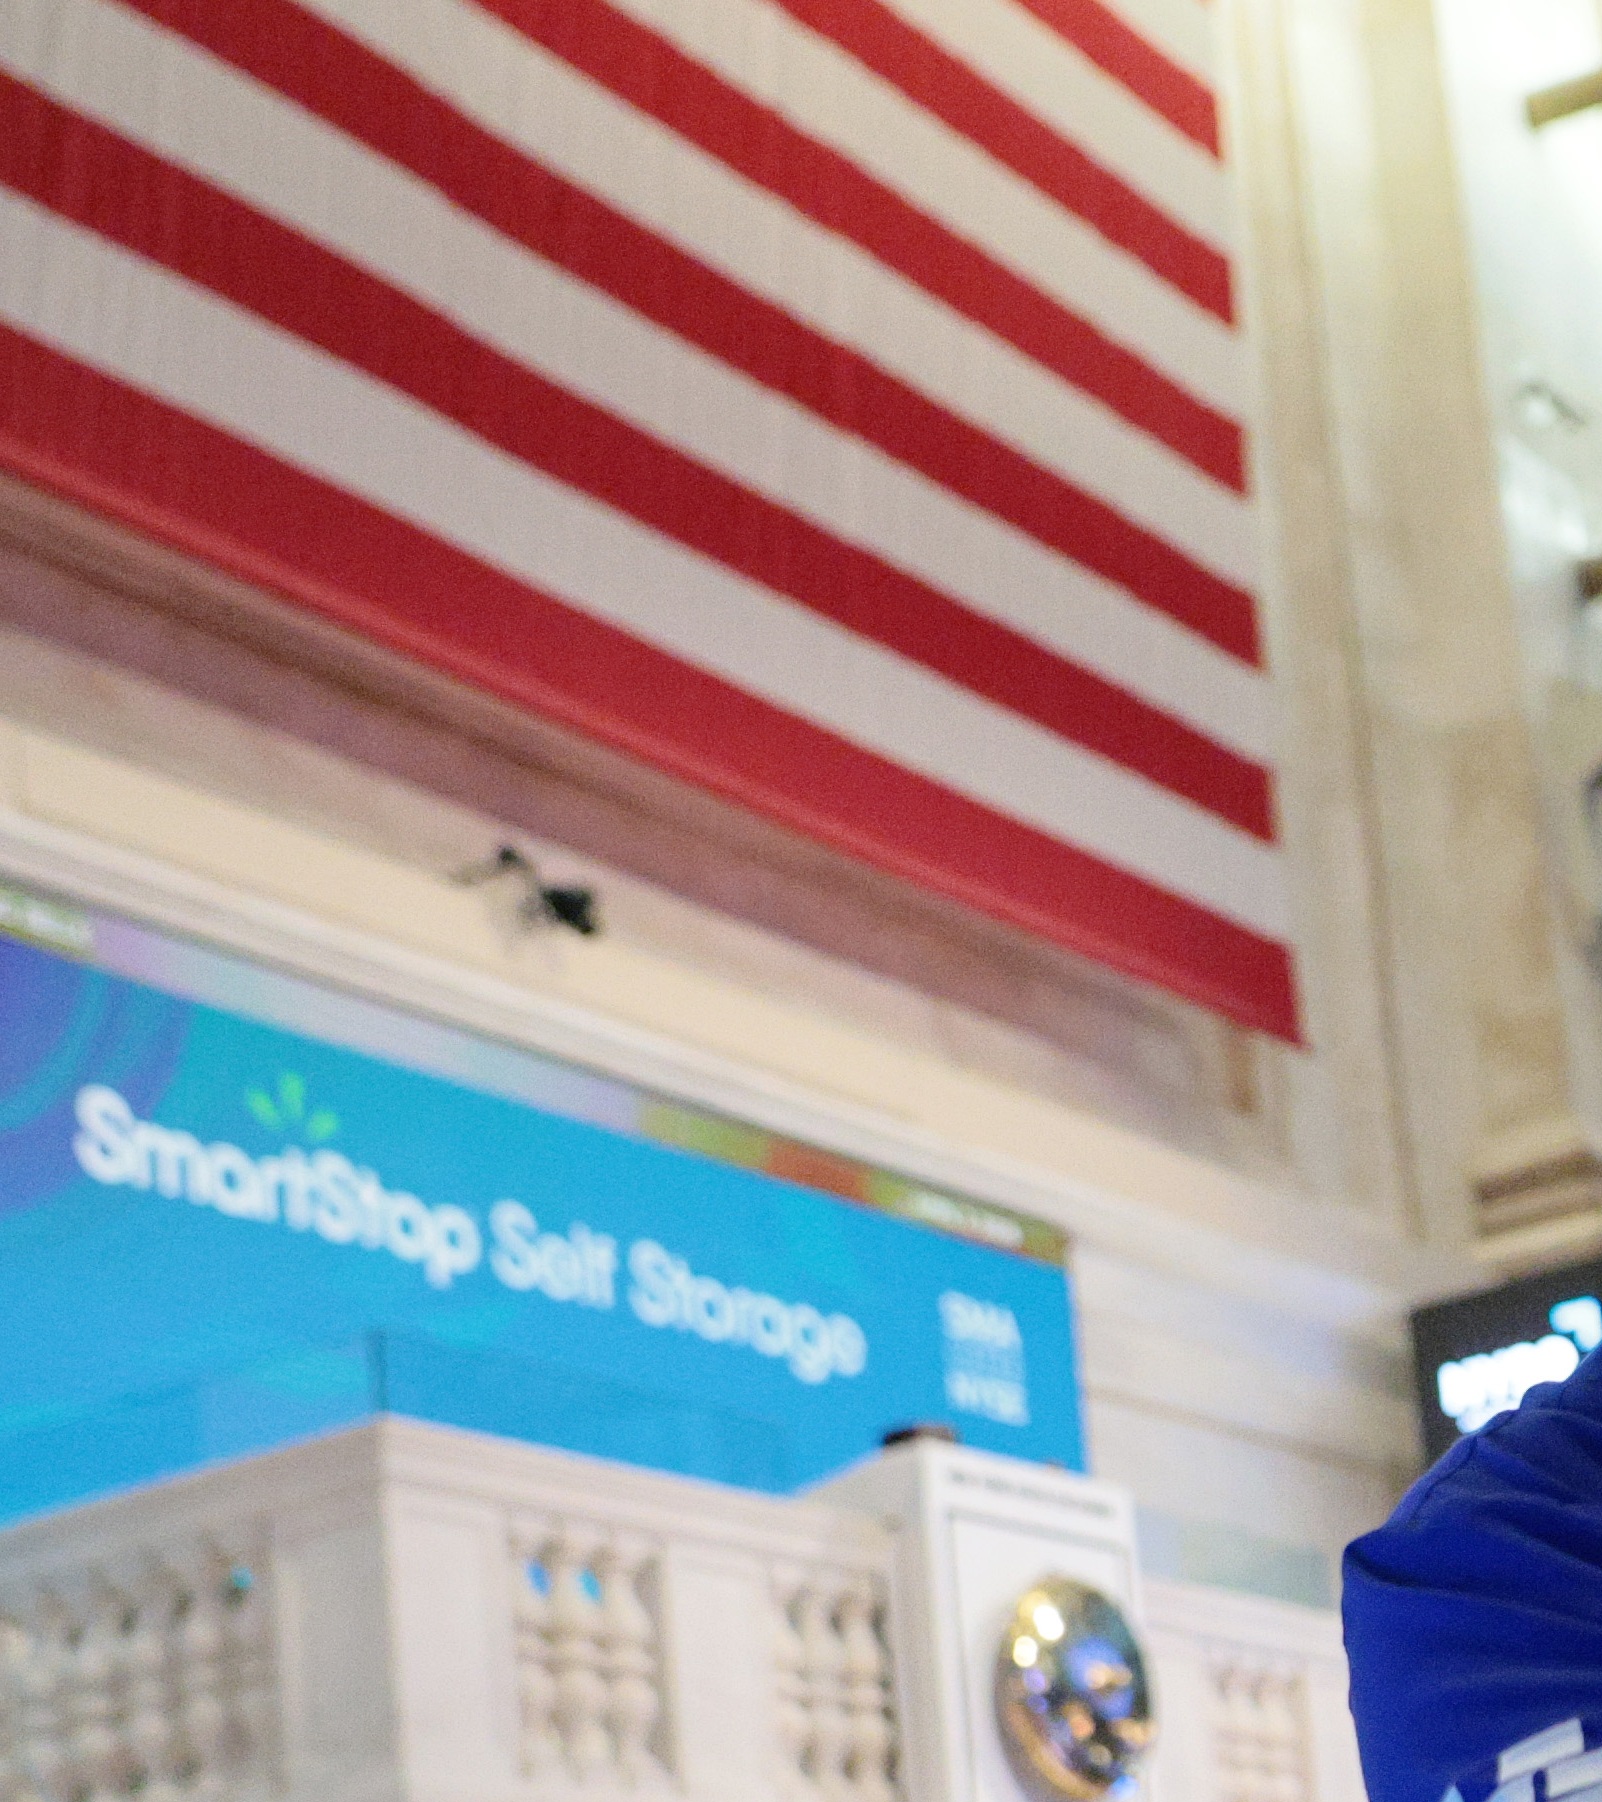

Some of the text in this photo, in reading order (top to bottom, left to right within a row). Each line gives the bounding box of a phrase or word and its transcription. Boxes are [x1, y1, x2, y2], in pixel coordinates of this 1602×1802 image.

[73, 1082, 868, 1385] SmartStop Self Storage
